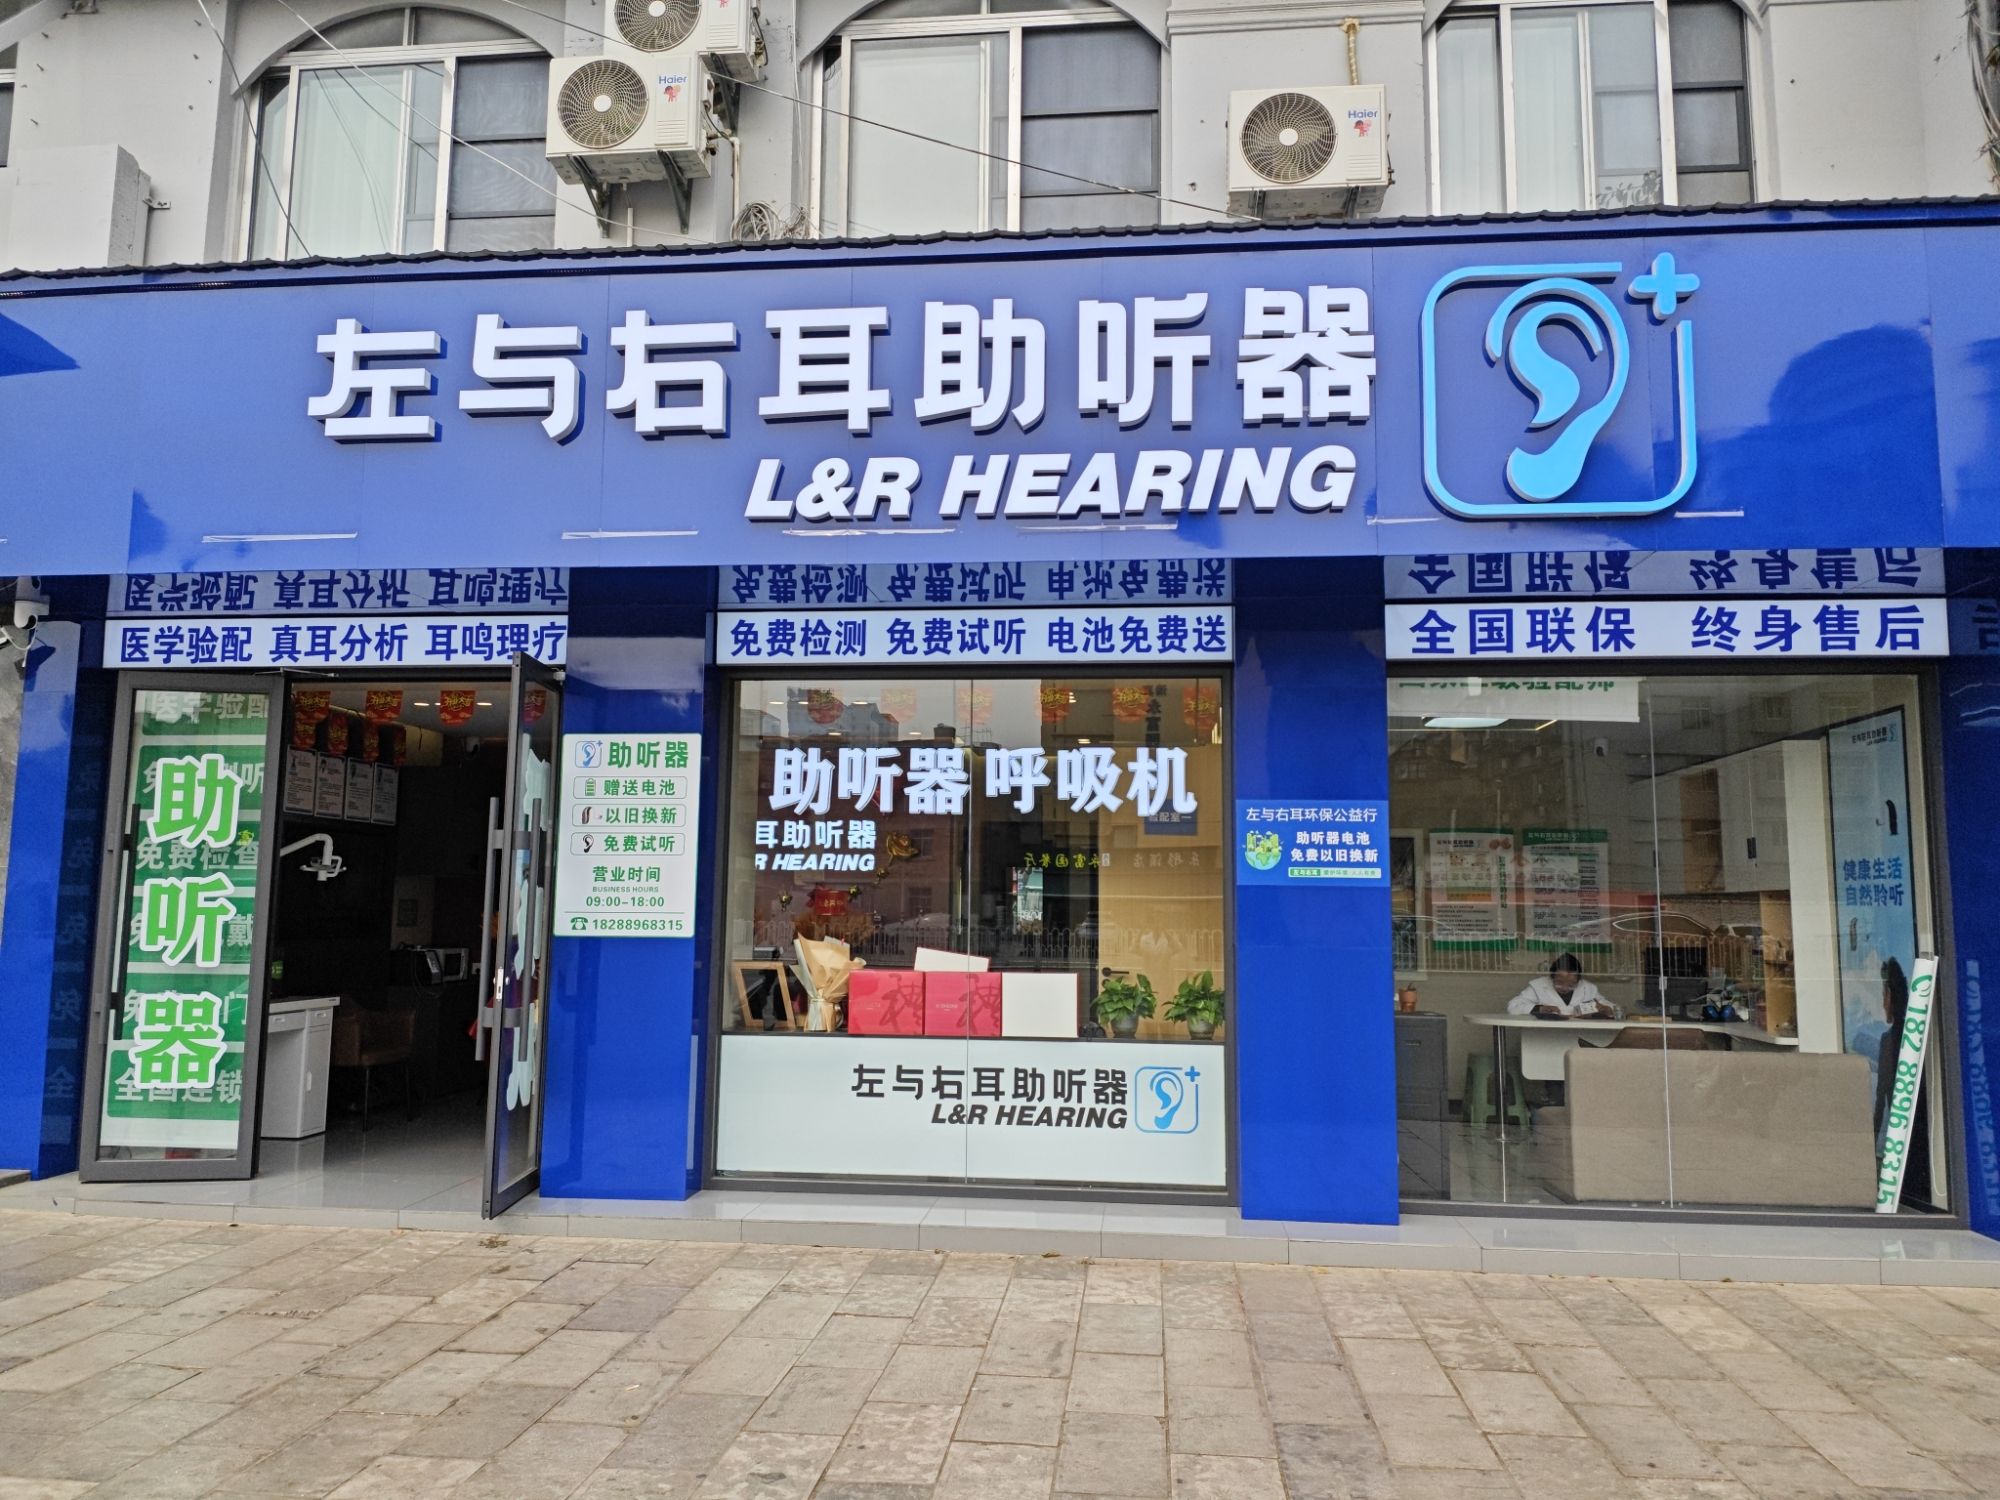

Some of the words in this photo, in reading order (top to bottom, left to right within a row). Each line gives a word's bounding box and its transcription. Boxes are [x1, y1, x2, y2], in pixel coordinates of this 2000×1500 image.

[658, 74, 687, 84] Haier
[1348, 109, 1378, 119] Haier
[308, 285, 1376, 441] 左与右耳助听器
[744, 457, 921, 519] L&R
[939, 444, 1357, 518] HEARING
[730, 619, 867, 657] 免费检测
[886, 617, 1025, 656] 免费试听
[1048, 615, 1226, 654] 电池免费送
[1409, 607, 1636, 654] 全国联保
[1691, 604, 1925, 652] 终身售后
[121, 625, 252, 663] 医学验配
[269, 623, 408, 662] 真耳分析
[425, 622, 567, 661] 耳鸣理疗
[608, 741, 688, 768] 助听器
[604, 779, 675, 796] 赠送电池
[769, 747, 971, 815] 助听器
[985, 747, 1198, 816] 呼吸机
[605, 807, 677, 824] 以旧换新
[1246, 807, 1378, 822] 左与右耳环保公益行
[604, 835, 675, 853] 免费试听
[1296, 831, 1370, 845] 助听器电池
[772, 853, 875, 871] HEARING
[1291, 848, 1378, 862] 免费以旧换新
[592, 866, 660, 882] 营业时间
[1843, 857, 1902, 881] 健康生活
[1846, 884, 1904, 907] 自然聆听
[131, 756, 241, 1087] 助听器
[592, 919, 683, 931] 18288968315
[1901, 1004, 1928, 1053] 182
[851, 1063, 1128, 1105] 左与右耳助听器
[1888, 1060, 1918, 1129] 8896
[931, 1103, 988, 1126] L&R
[995, 1106, 1128, 1130] HEARING
[1876, 1137, 1905, 1205] 8315
